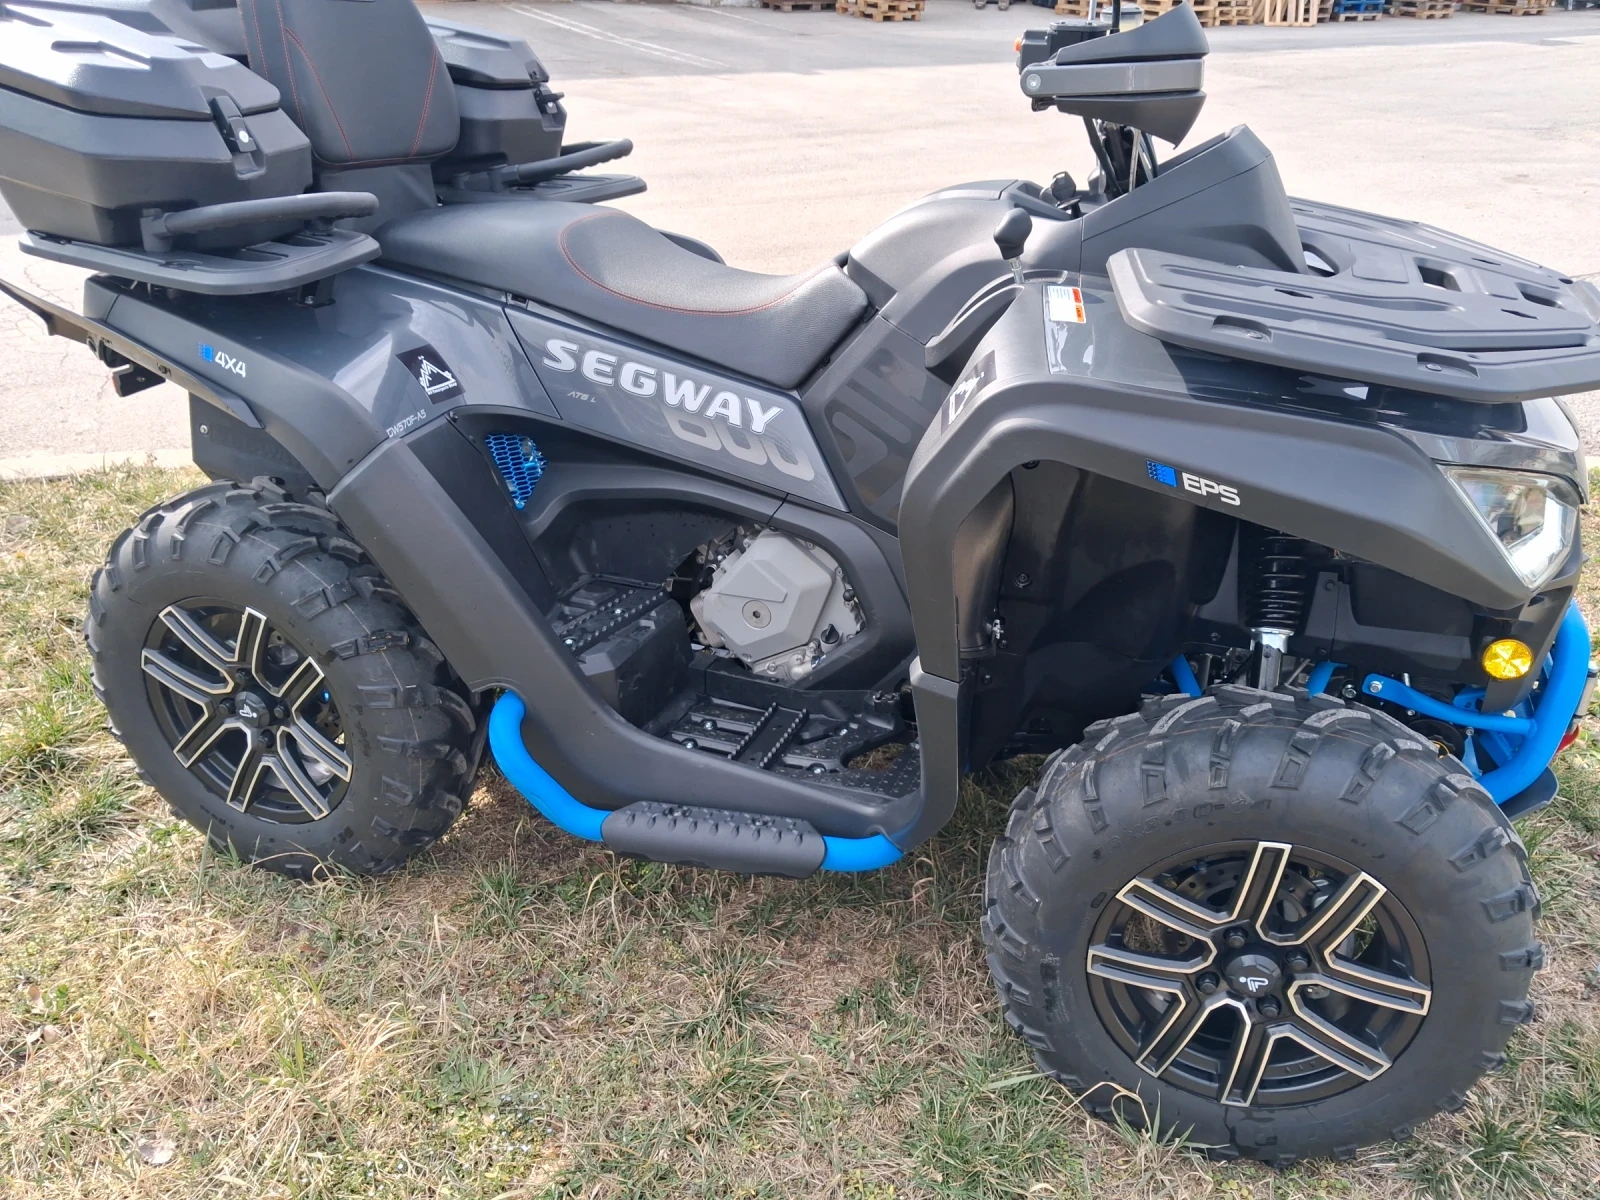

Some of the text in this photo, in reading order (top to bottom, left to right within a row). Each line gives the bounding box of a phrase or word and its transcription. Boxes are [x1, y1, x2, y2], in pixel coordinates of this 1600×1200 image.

[215, 351, 246, 378] 4X4
[542, 338, 784, 434] SEGWAY
[567, 391, 590, 401] AT6
[1182, 472, 1241, 506] EPS
